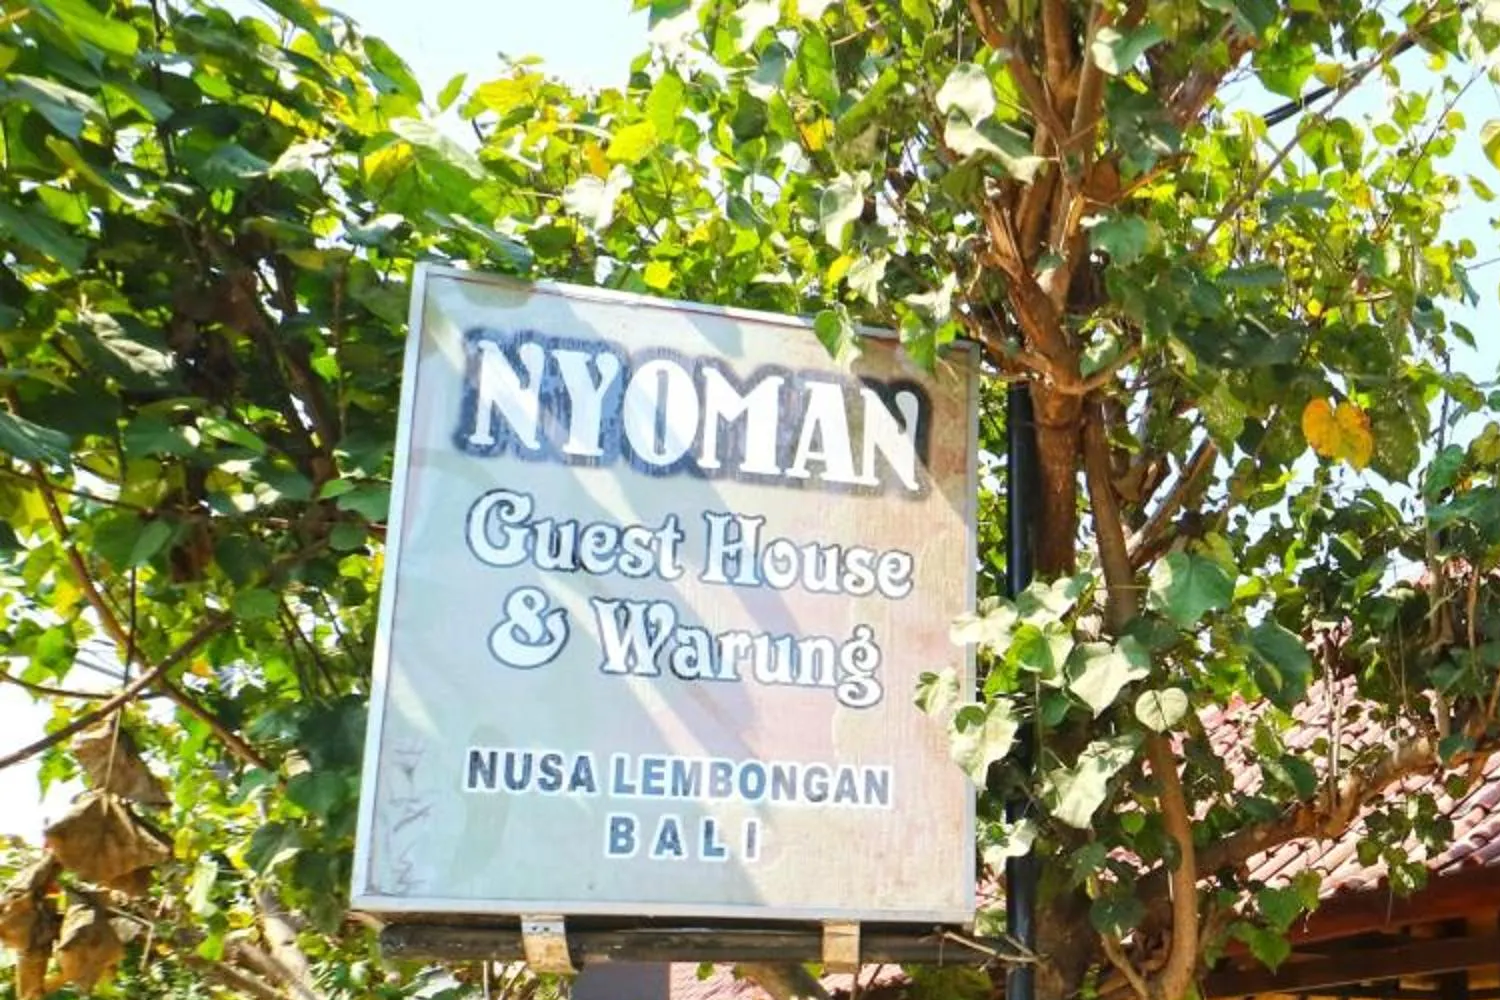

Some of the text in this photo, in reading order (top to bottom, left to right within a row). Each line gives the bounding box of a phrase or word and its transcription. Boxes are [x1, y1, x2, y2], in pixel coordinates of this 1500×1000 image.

[464, 338, 921, 491] NYOMAN
[465, 488, 914, 598] Guest House
[487, 585, 883, 708] & Warung
[467, 748, 890, 806] NUSA LEMBONGAN
[606, 815, 760, 859] BALI
